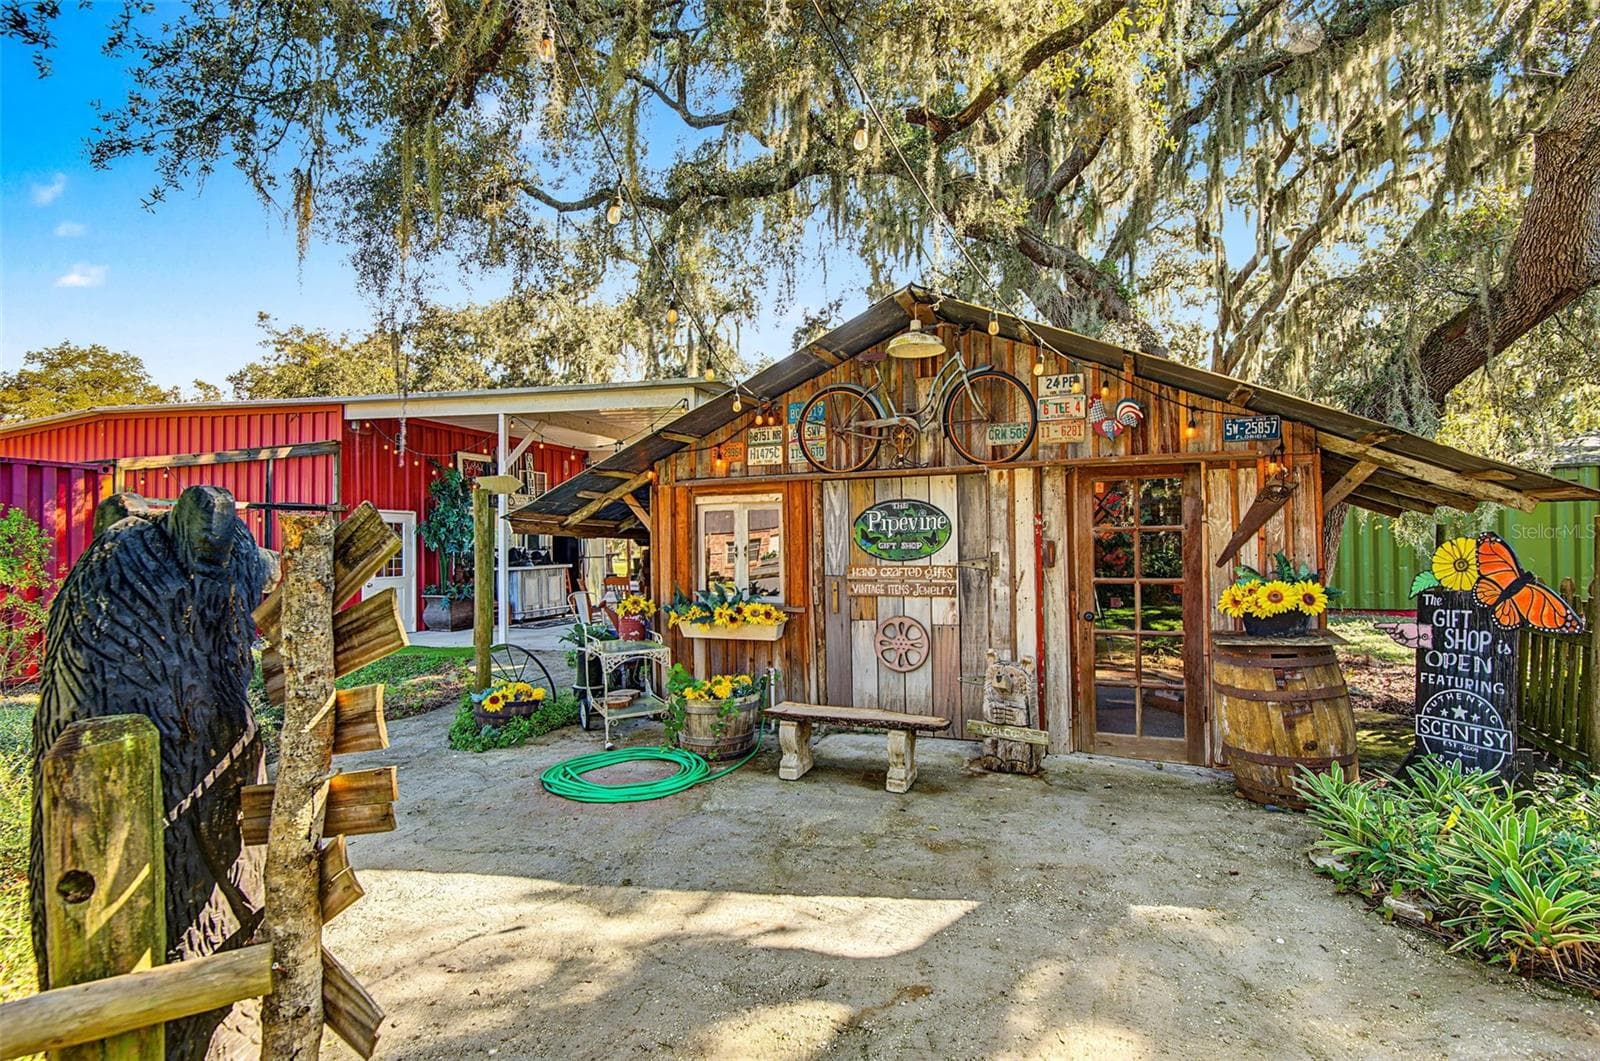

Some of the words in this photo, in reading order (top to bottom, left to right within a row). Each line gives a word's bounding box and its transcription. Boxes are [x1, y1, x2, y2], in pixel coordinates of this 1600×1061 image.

[1046, 378, 1060, 389] 24
[866, 510, 947, 537] Pipevine
[852, 583, 885, 595] VINTAGE
[1432, 609, 1472, 629] GIFT
[1444, 628, 1492, 653] SHOP
[1498, 640, 1512, 655] is
[1425, 650, 1492, 674] OPEN
[1420, 672, 1505, 695] FEATURING
[1426, 692, 1498, 724] AUTHENTIC
[1420, 718, 1508, 752] SCENTSY
